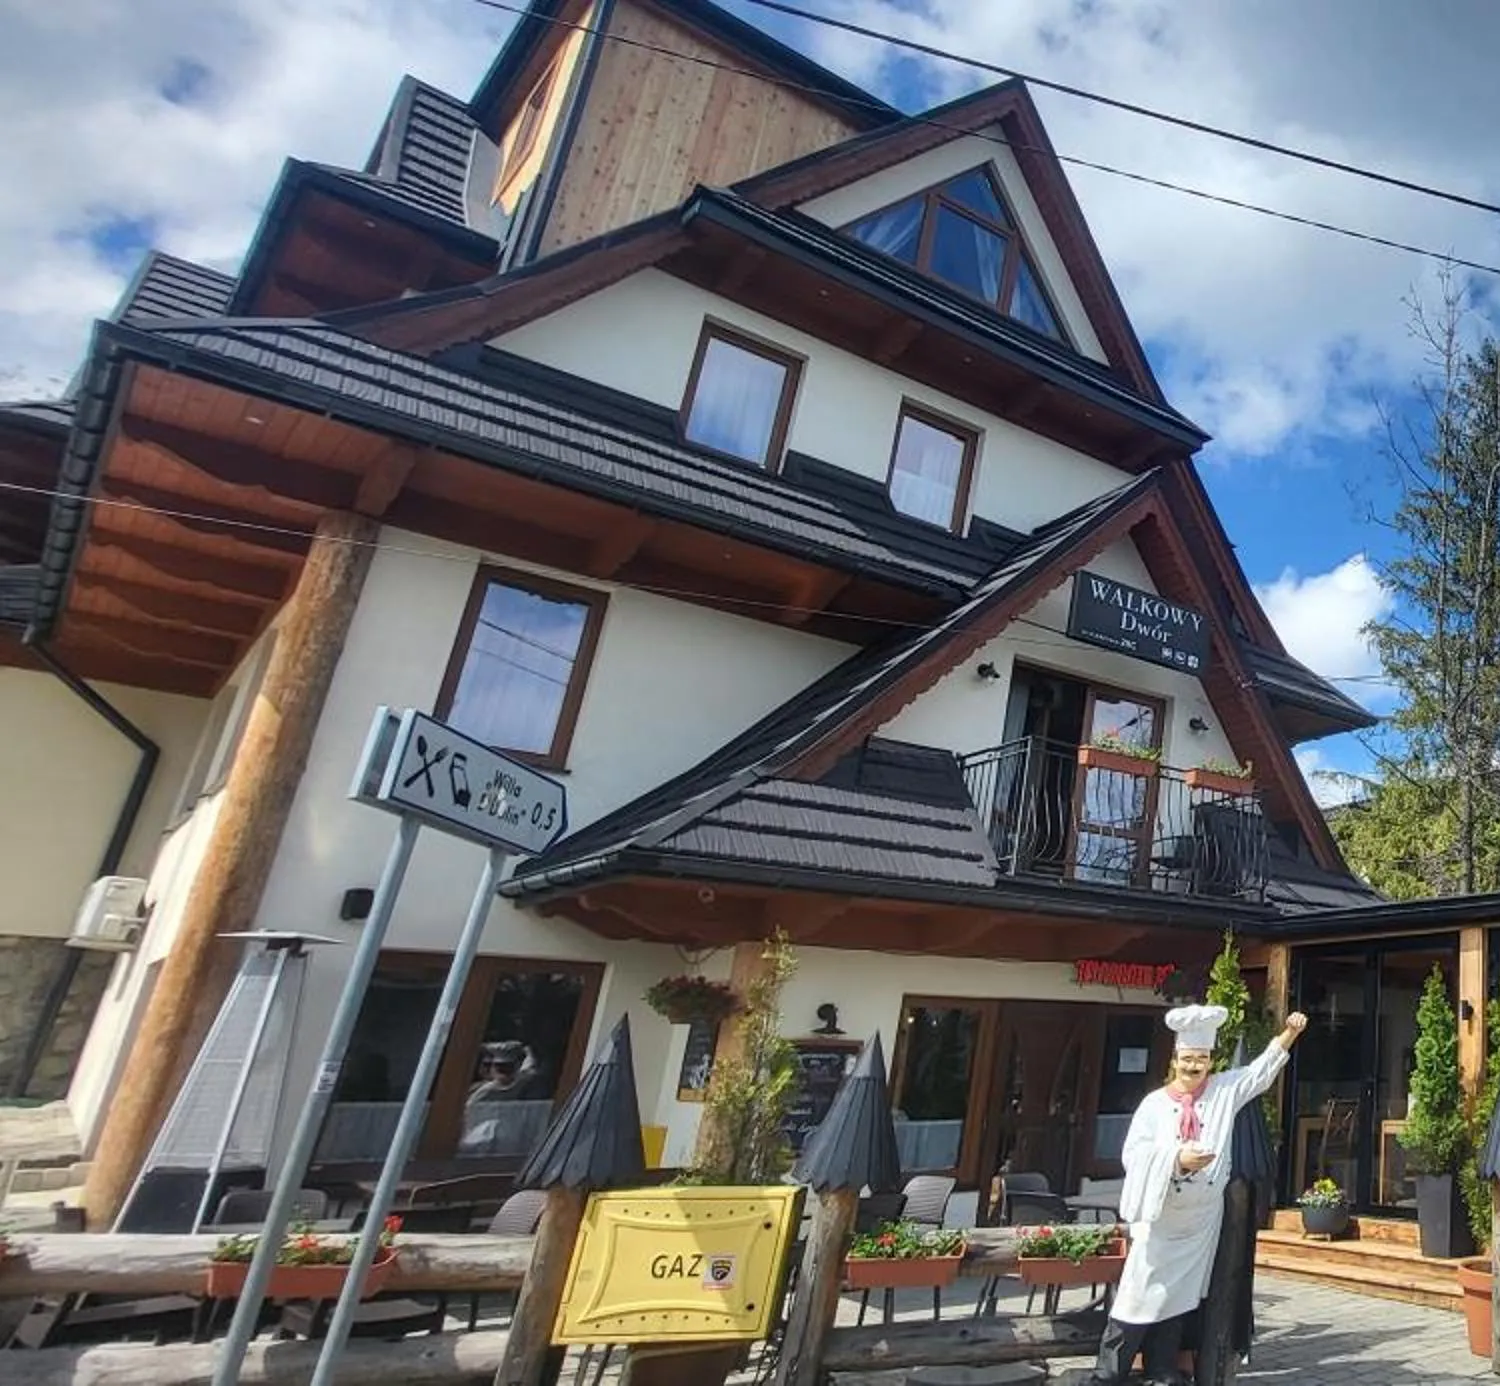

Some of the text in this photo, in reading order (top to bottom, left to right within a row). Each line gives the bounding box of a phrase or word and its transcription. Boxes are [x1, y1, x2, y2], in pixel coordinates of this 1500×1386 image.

[1090, 577, 1204, 633] WALKOWY
[1119, 611, 1174, 643] Dwór
[531, 801, 557, 830] 0,5
[650, 1254, 704, 1280] GAZ
